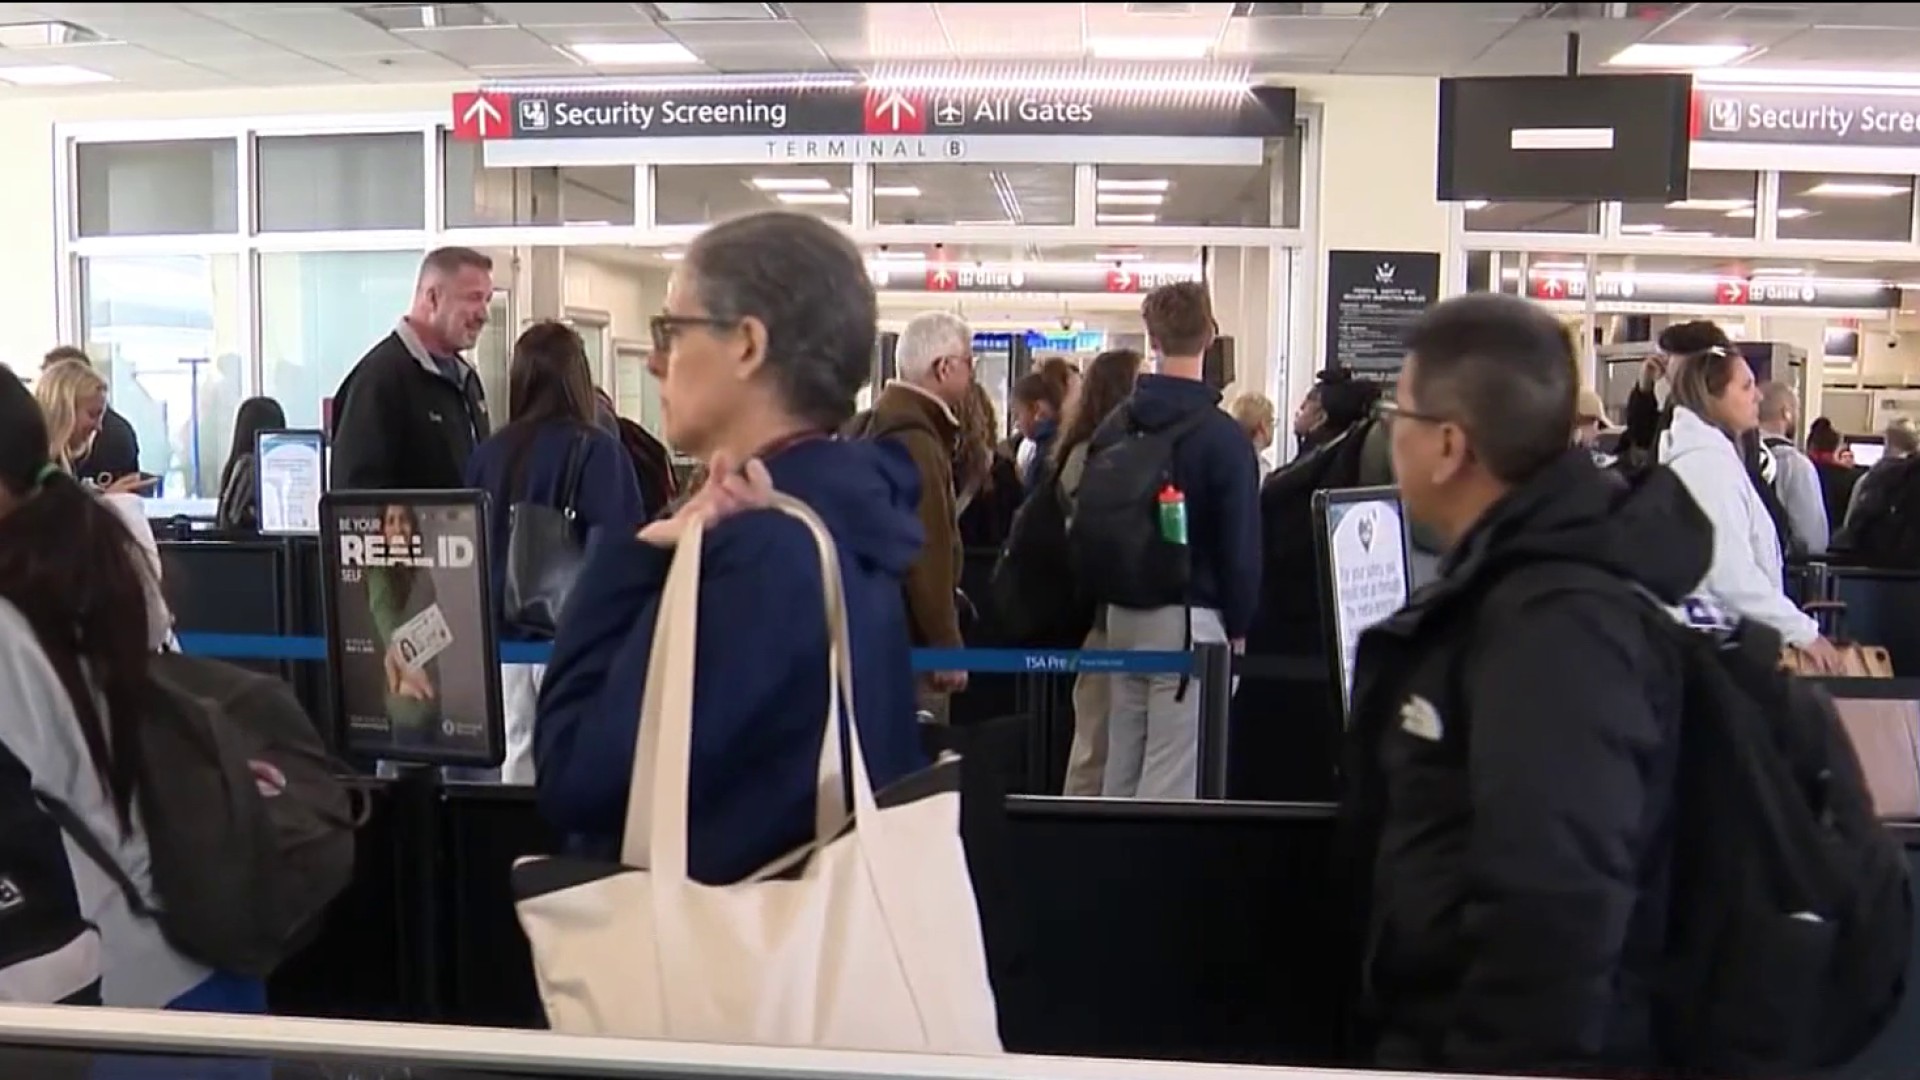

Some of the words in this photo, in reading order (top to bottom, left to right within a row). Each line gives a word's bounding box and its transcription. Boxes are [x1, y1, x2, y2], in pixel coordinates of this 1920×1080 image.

[554, 100, 654, 130] Security
[661, 98, 787, 128] Screening
[973, 100, 1010, 122] All
[1018, 100, 1094, 123] Gates
[1747, 102, 1853, 137] Security
[765, 140, 926, 158] TERMINAL
[339, 518, 351, 531] BE
[352, 518, 381, 532] YOUR
[340, 534, 434, 567] REAL
[437, 534, 474, 568] ID
[341, 568, 361, 583] SELF
[1025, 655, 1046, 670] TSA
[1048, 655, 1067, 670] Pre
